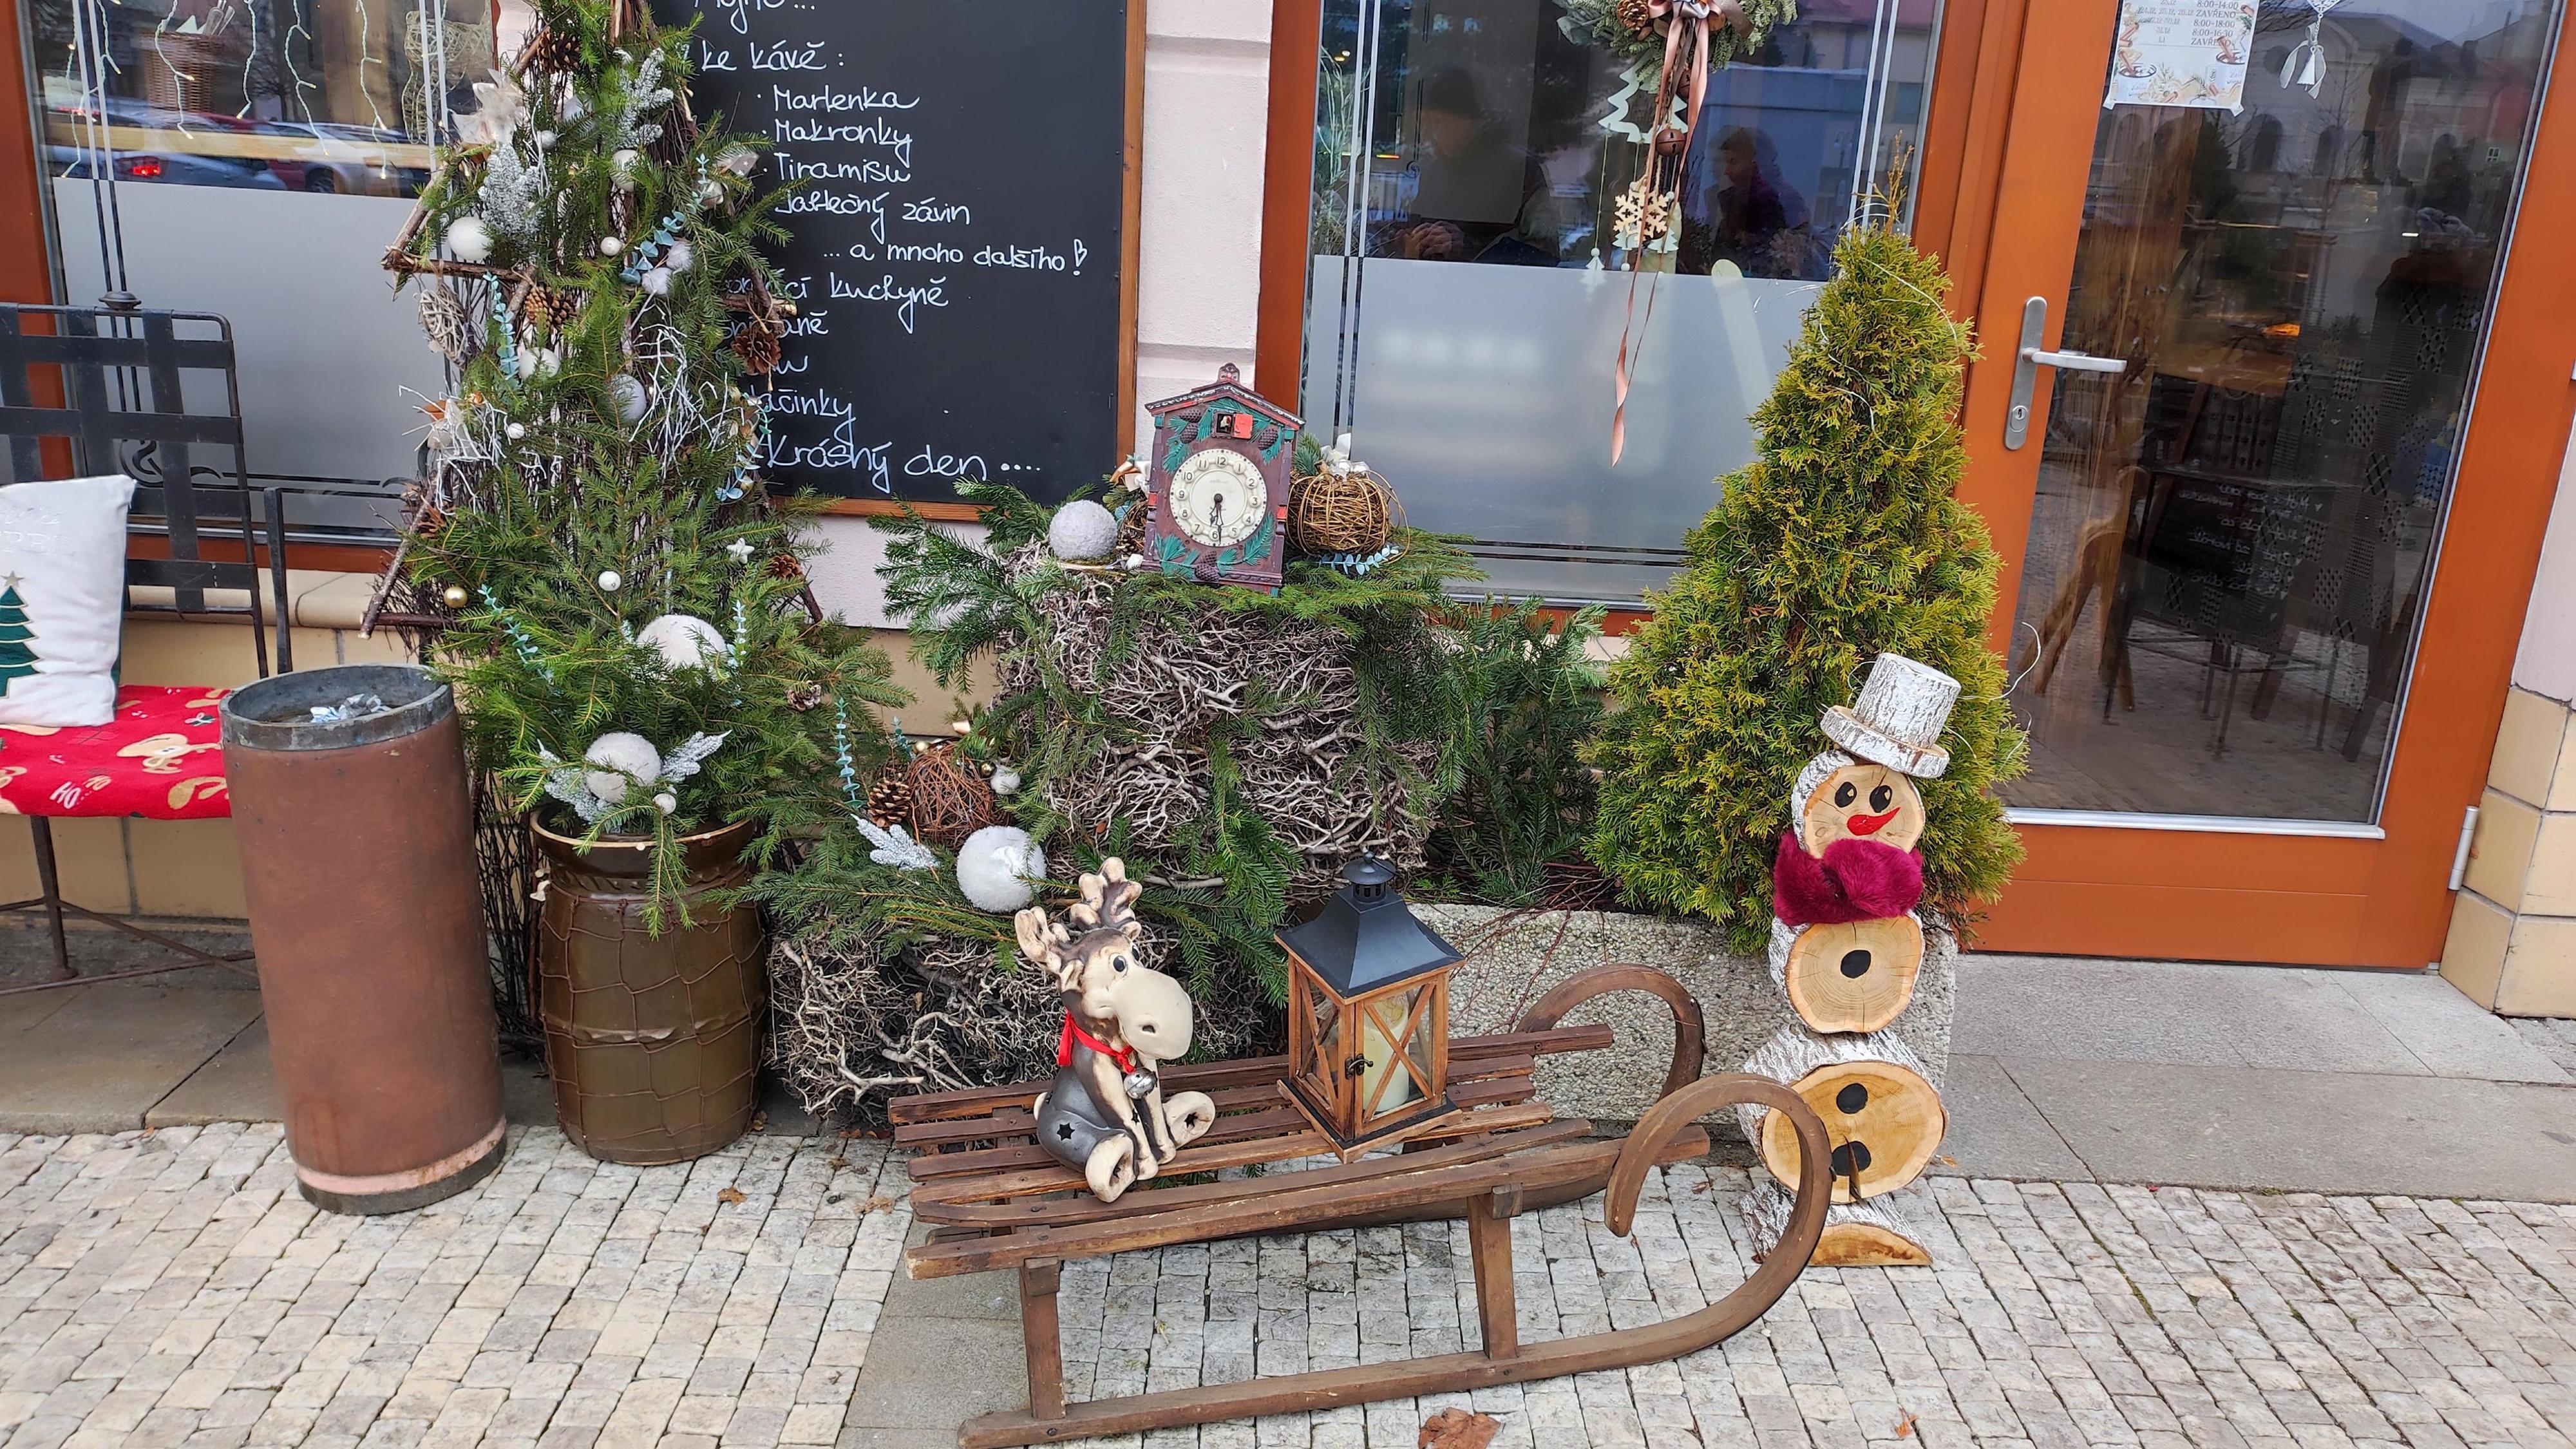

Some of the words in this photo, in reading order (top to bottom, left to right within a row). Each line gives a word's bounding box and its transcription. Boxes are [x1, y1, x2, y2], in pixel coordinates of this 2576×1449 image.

[2196, 9, 2236, 18] ZAVŘENO
[2191, 37, 2231, 46] ZAVŘEO
[702, 40, 737, 71] ke
[773, 84, 920, 112] Marlenka
[774, 117, 913, 167] Makronky
[774, 153, 911, 183] Tiramisu
[902, 198, 970, 225] závin
[887, 243, 963, 263] mnoho
[830, 272, 948, 334] kuchyně
[905, 445, 986, 480] den
[1199, 460, 1206, 468] 11
[1217, 457, 1226, 465] 12
[1184, 472, 1193, 480] 10
[1249, 478, 1255, 487] 2
[1179, 490, 1185, 498] 9
[1253, 497, 1258, 506] 3
[1182, 509, 1188, 518] 8
[1195, 524, 1200, 532] 7
